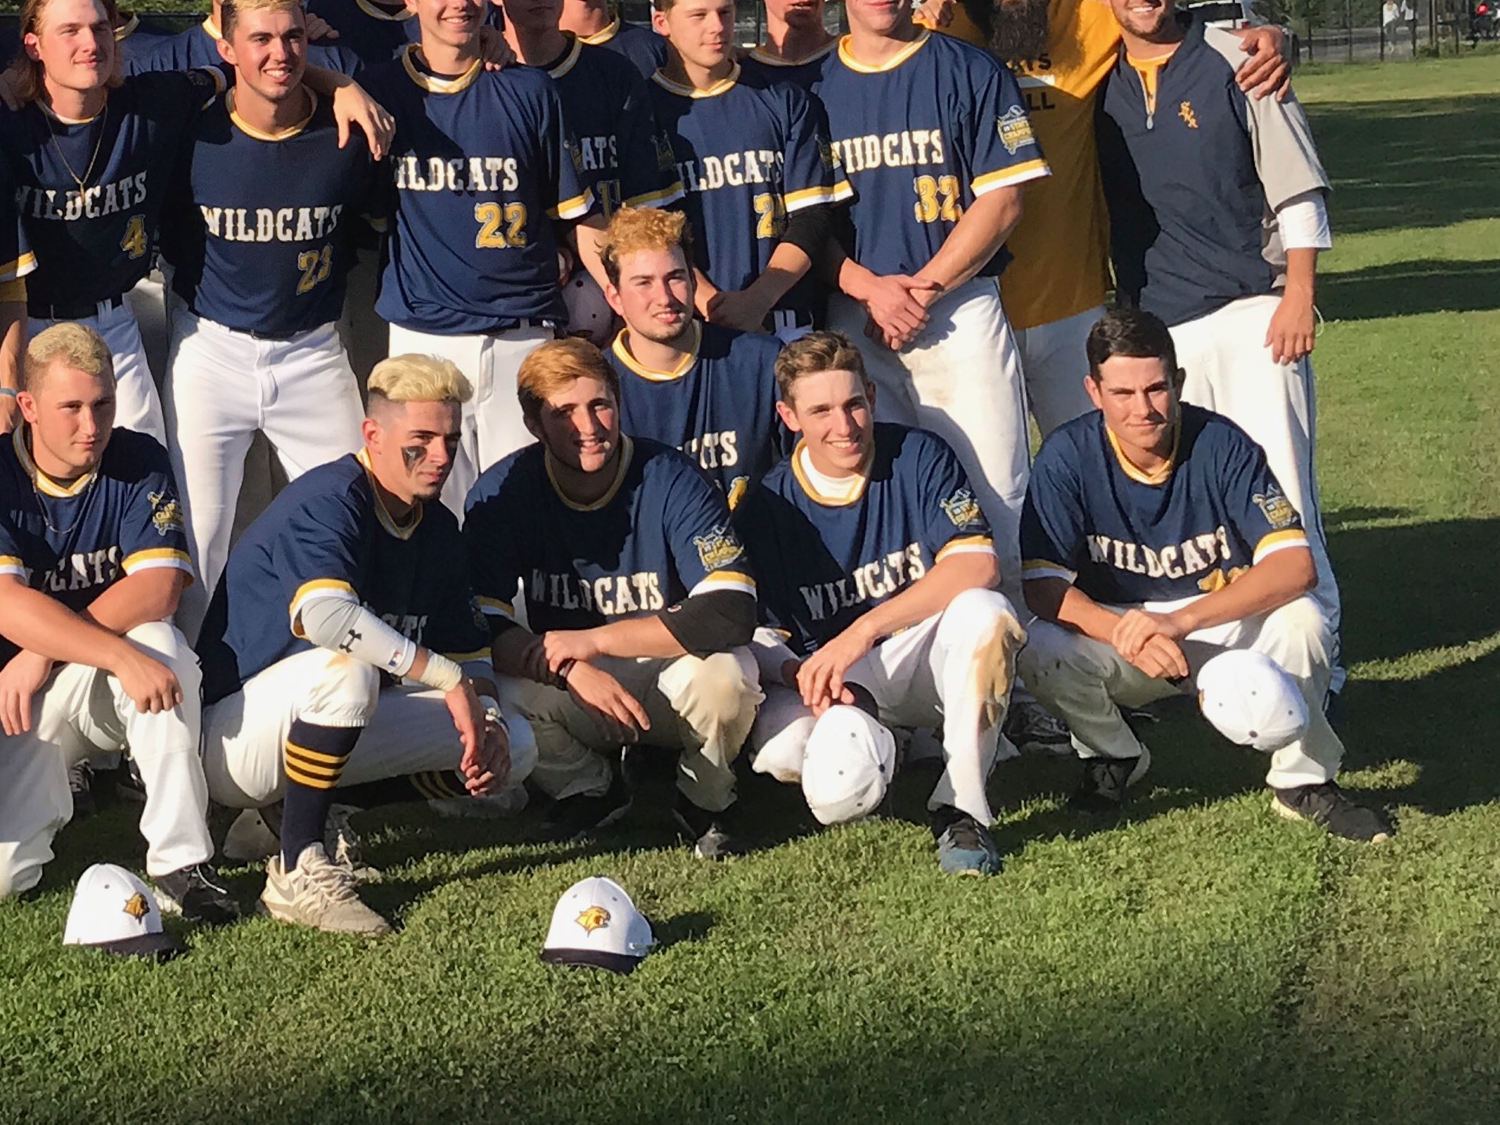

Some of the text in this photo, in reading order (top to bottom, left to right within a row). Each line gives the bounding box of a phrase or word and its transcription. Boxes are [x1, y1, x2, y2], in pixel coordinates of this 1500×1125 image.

[119, 214, 149, 260] 4
[201, 204, 343, 243] WILDCATS
[474, 202, 527, 249] 22
[1086, 525, 1231, 579] WILDCATS
[531, 568, 664, 616] WILDCATS
